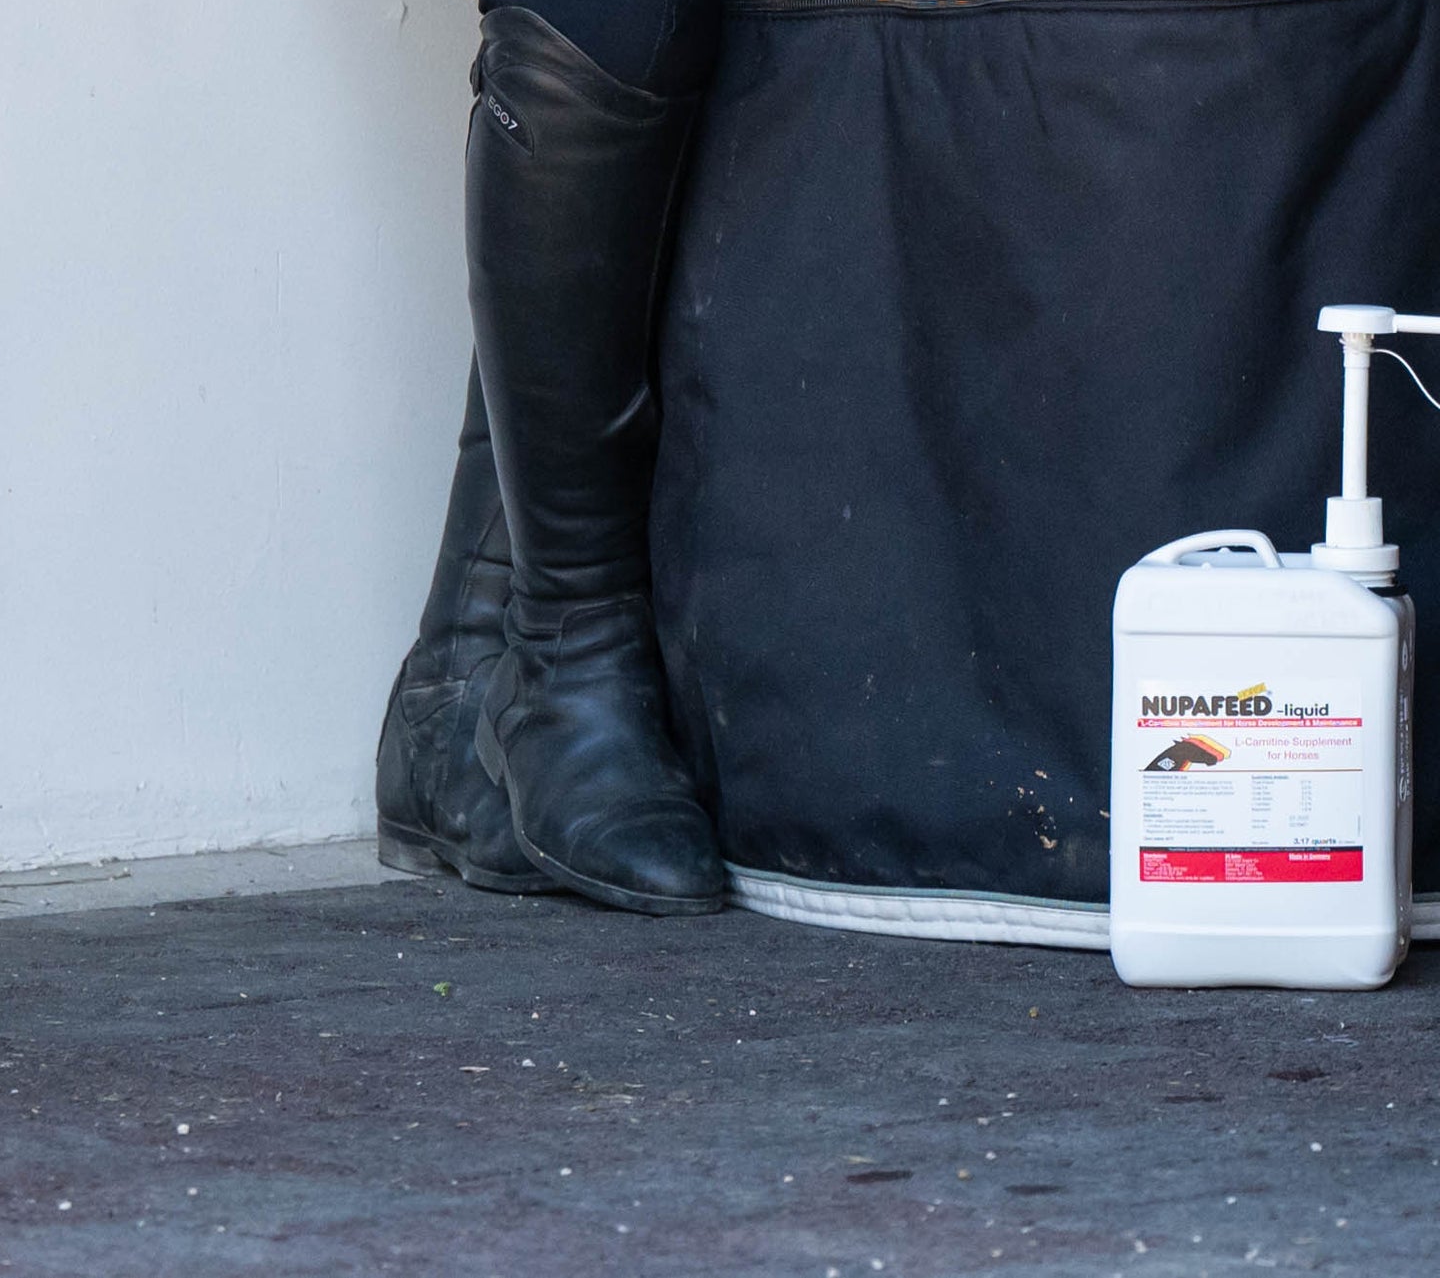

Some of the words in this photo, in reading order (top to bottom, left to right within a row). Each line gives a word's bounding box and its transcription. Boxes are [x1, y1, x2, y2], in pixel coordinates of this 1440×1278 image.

[487, 94, 519, 131] EGO7
[1141, 695, 1273, 717] NUPAFEED
[1234, 736, 1288, 748] L-Carnitine
[1292, 736, 1353, 749] Supplement
[1267, 750, 1281, 761] for
[1283, 750, 1320, 761] Horses
